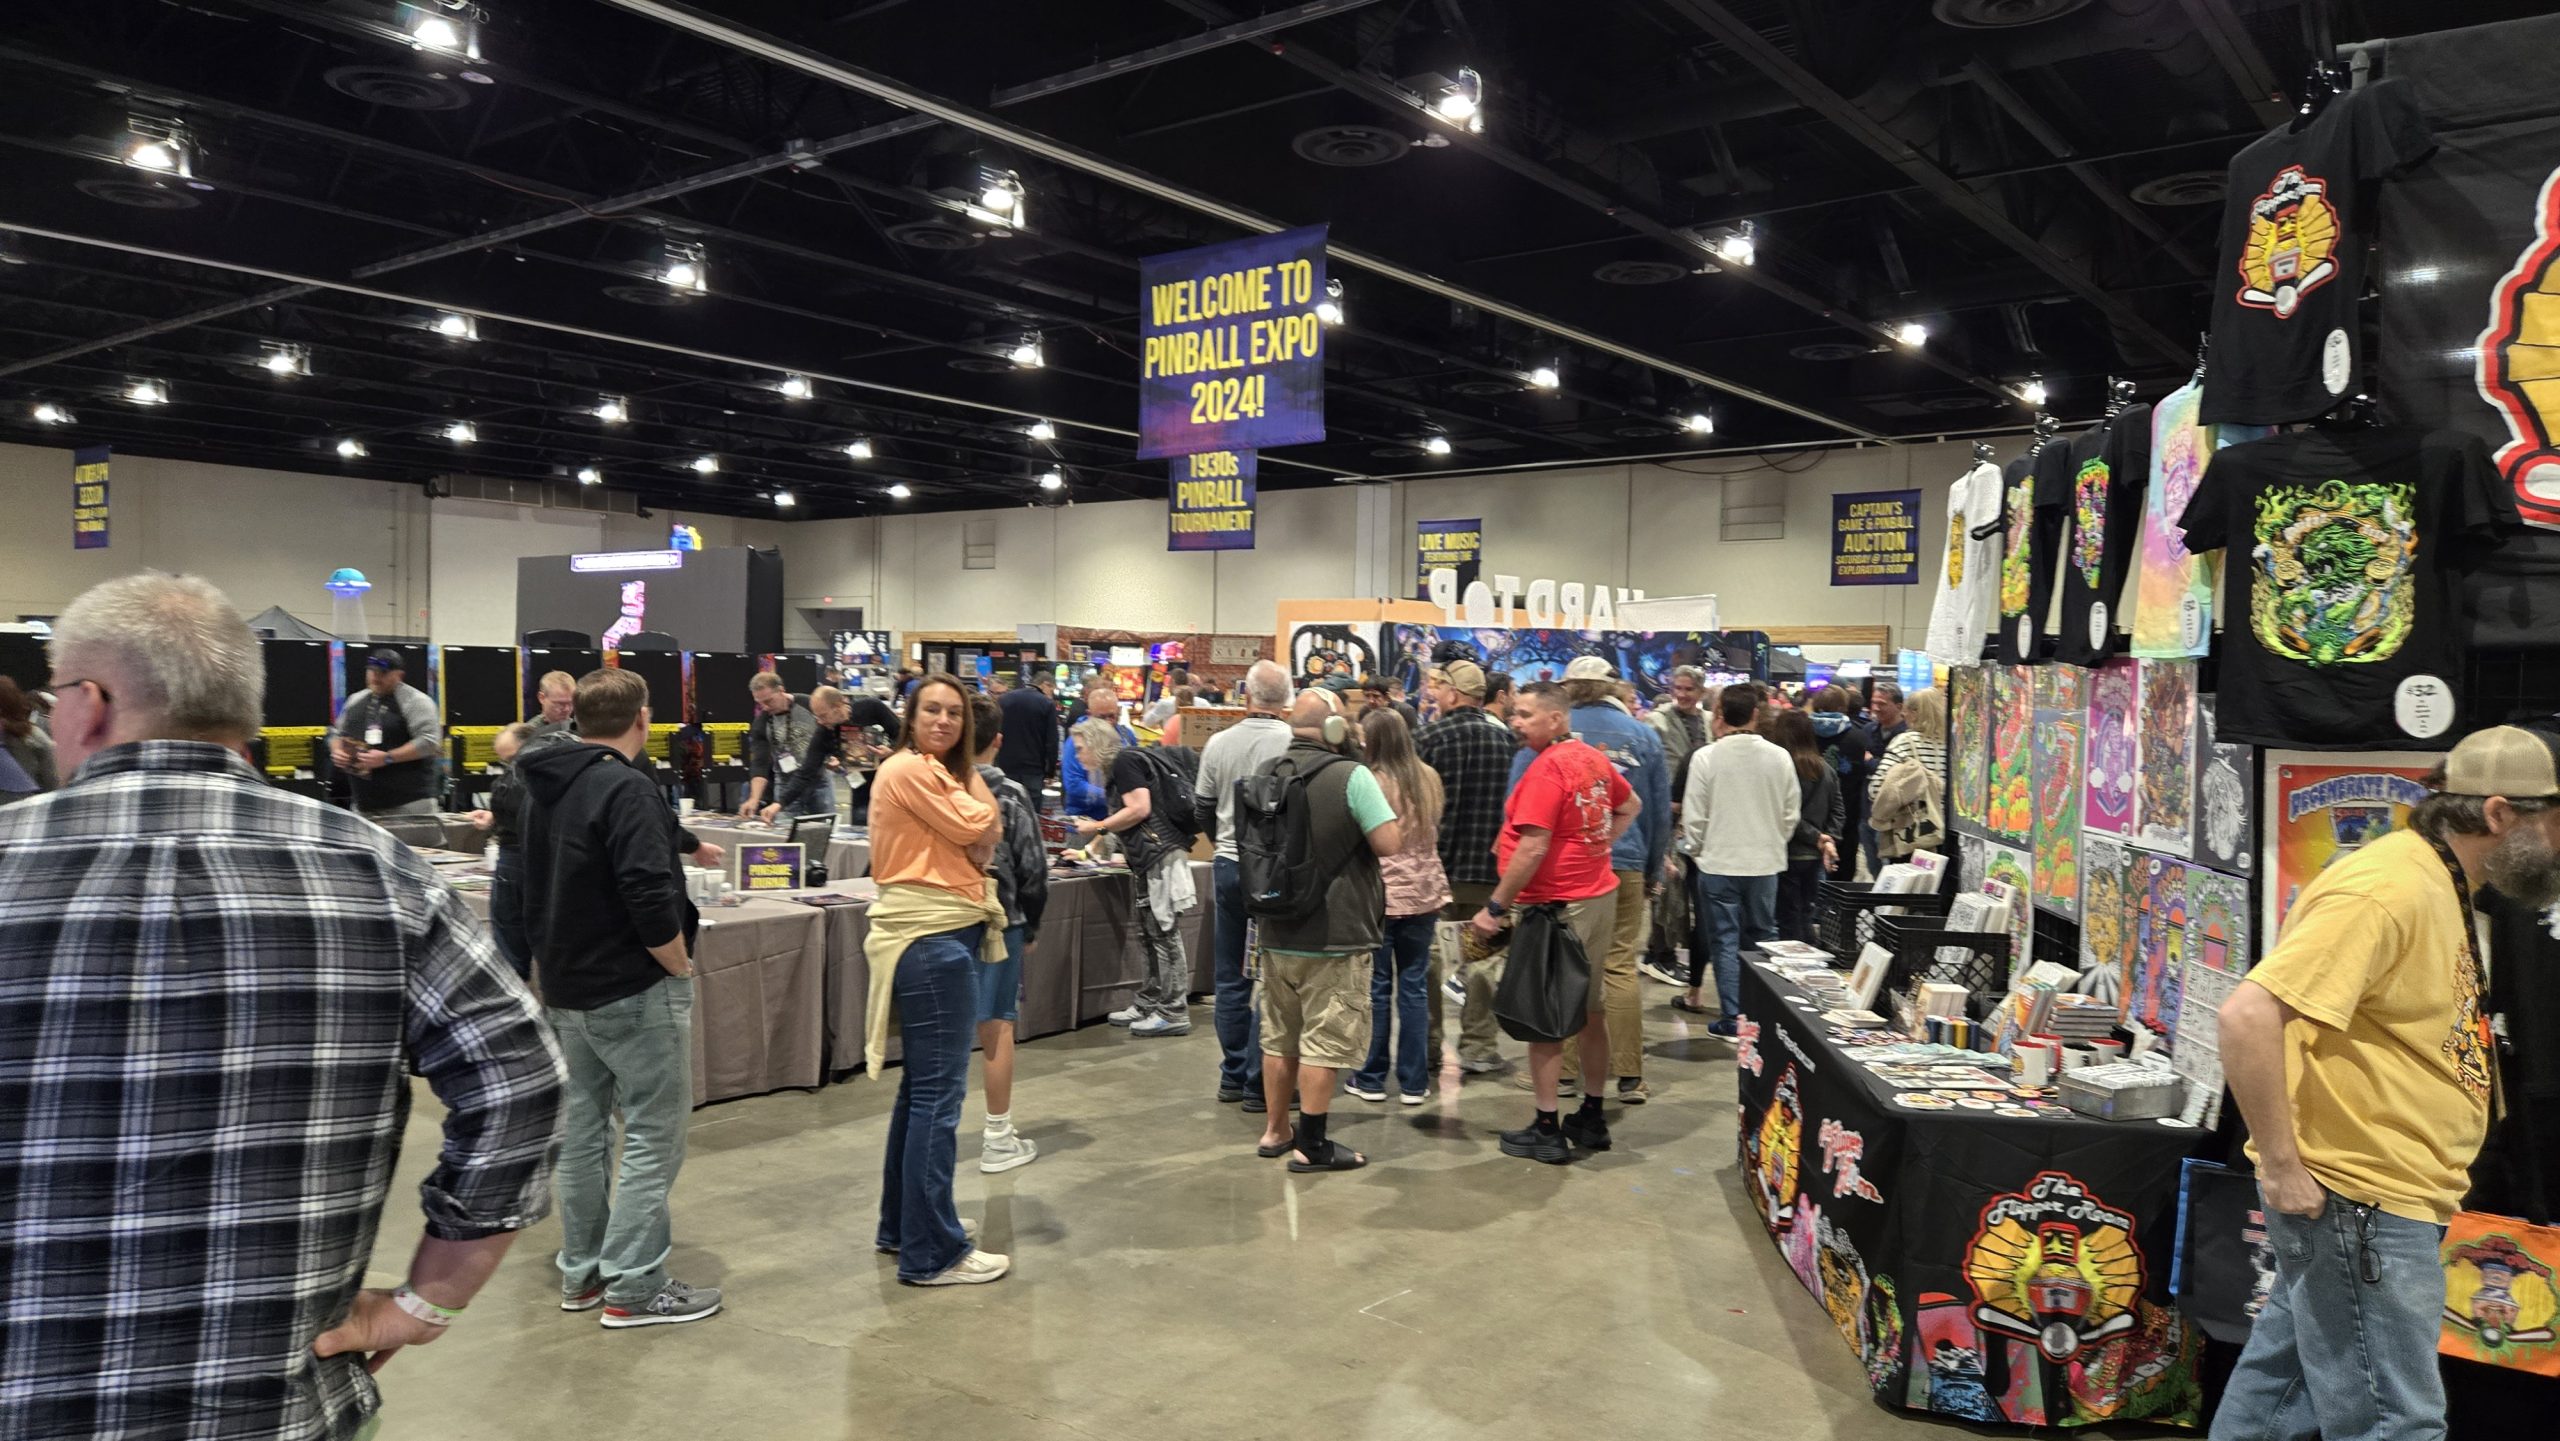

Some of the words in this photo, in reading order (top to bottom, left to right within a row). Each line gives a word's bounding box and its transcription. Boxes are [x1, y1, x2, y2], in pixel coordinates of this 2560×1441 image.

[1152, 266, 1272, 326] WELCOME
[1277, 259, 1312, 306] TO
[1145, 325, 1245, 379] PINBALL
[1251, 312, 1318, 365] EXPO
[1190, 374, 1265, 424] 2024!
[1189, 451, 1239, 478] 1930s
[1177, 479, 1247, 509] PINBALL
[1849, 501, 1904, 518] CAPTAIN'S
[1171, 510, 1253, 533] TOURNAMENT
[1838, 518, 1865, 531] GAME
[1865, 518, 1874, 530] &
[1875, 516, 1915, 530] PINBALL
[1418, 533, 1443, 551] LIVE
[1444, 532, 1480, 550] MUSIC
[1843, 531, 1907, 552] AUCTION
[1835, 555, 1870, 565] SATURDAY
[1871, 553, 1881, 564] @
[1838, 565, 1885, 575] EXPLORATION
[2031, 1176, 2083, 1199] The
[1987, 1199, 2065, 1225] Flipper
[2066, 1200, 2131, 1230] Room
